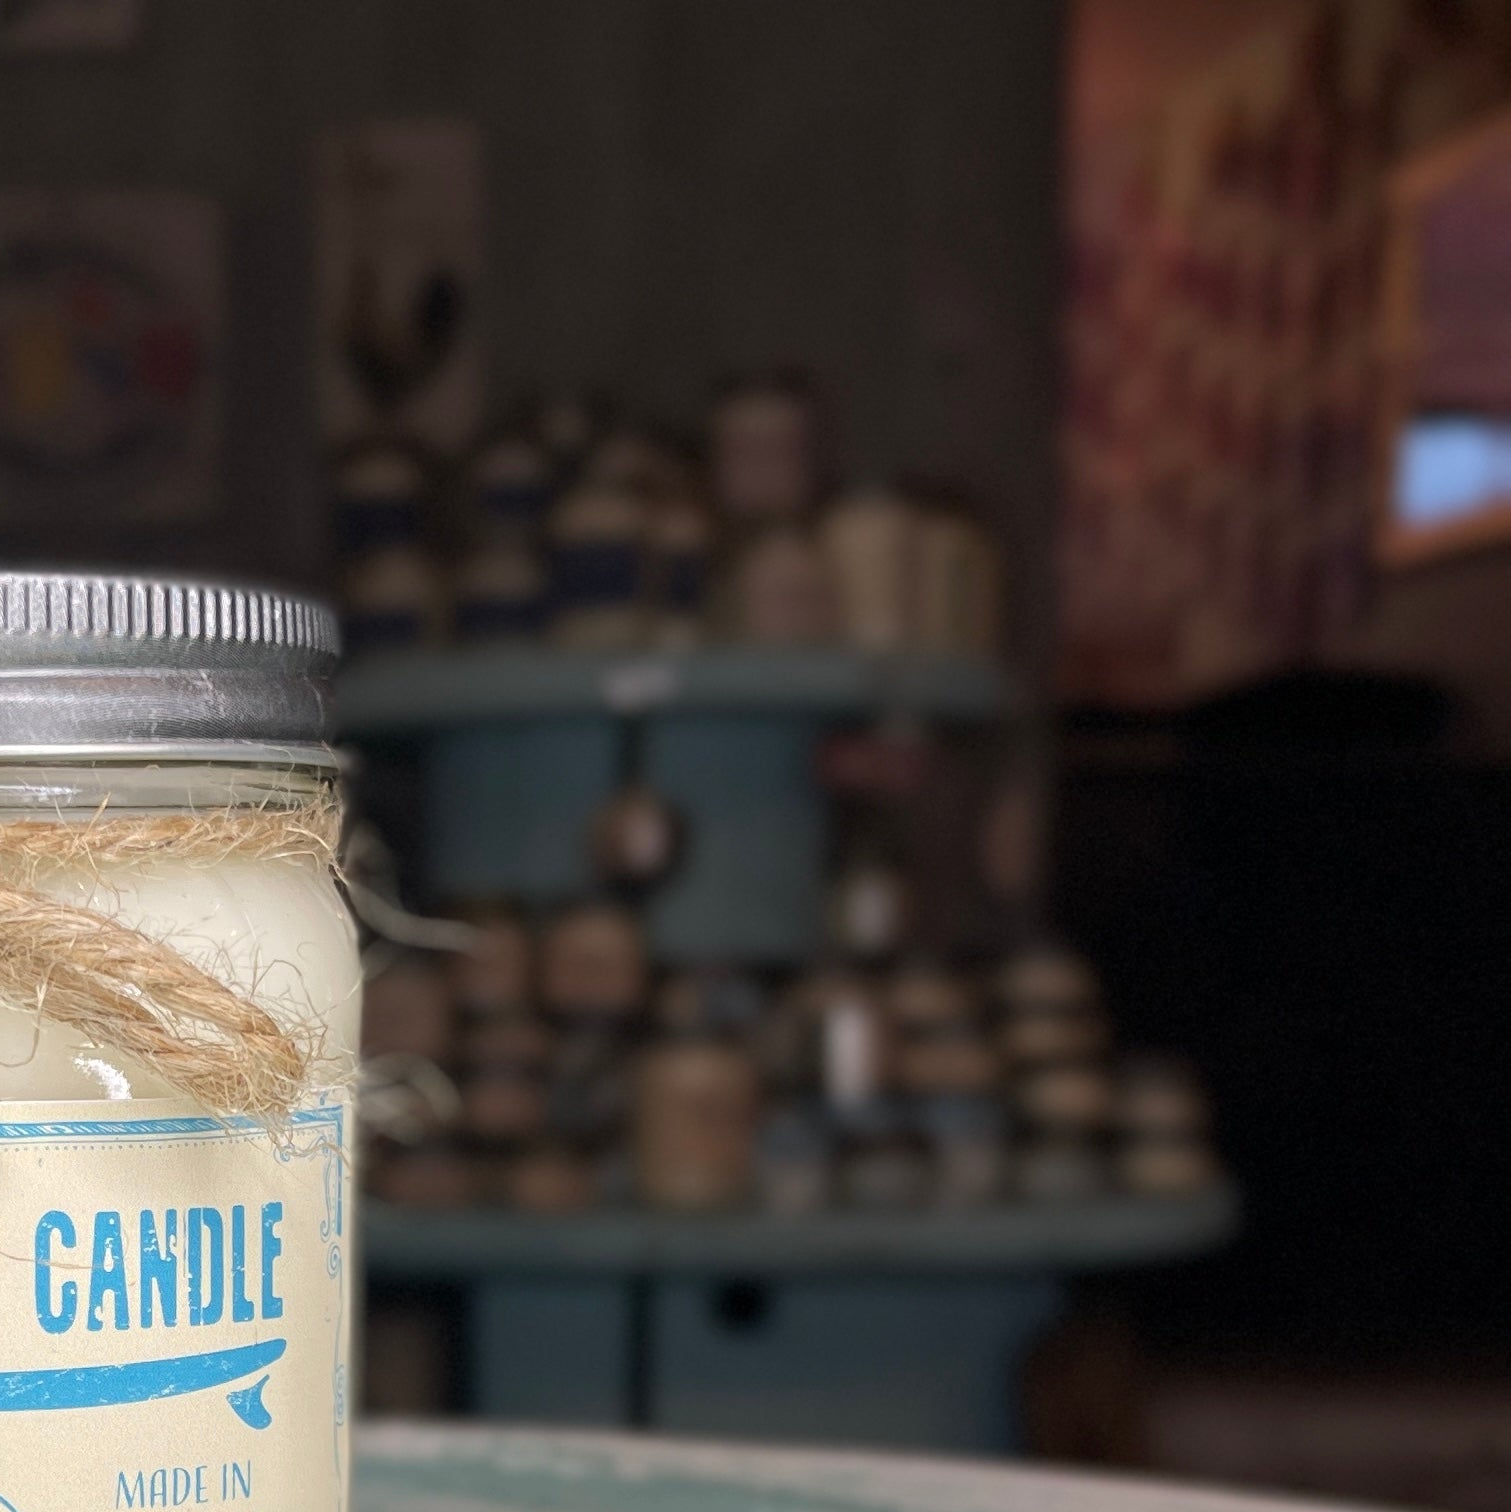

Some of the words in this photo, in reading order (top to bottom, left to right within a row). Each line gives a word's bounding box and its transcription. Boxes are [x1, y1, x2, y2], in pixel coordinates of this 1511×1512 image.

[33, 1201, 285, 1334] CANDLE
[115, 1464, 209, 1509] MADE
[221, 1459, 253, 1500] IN
